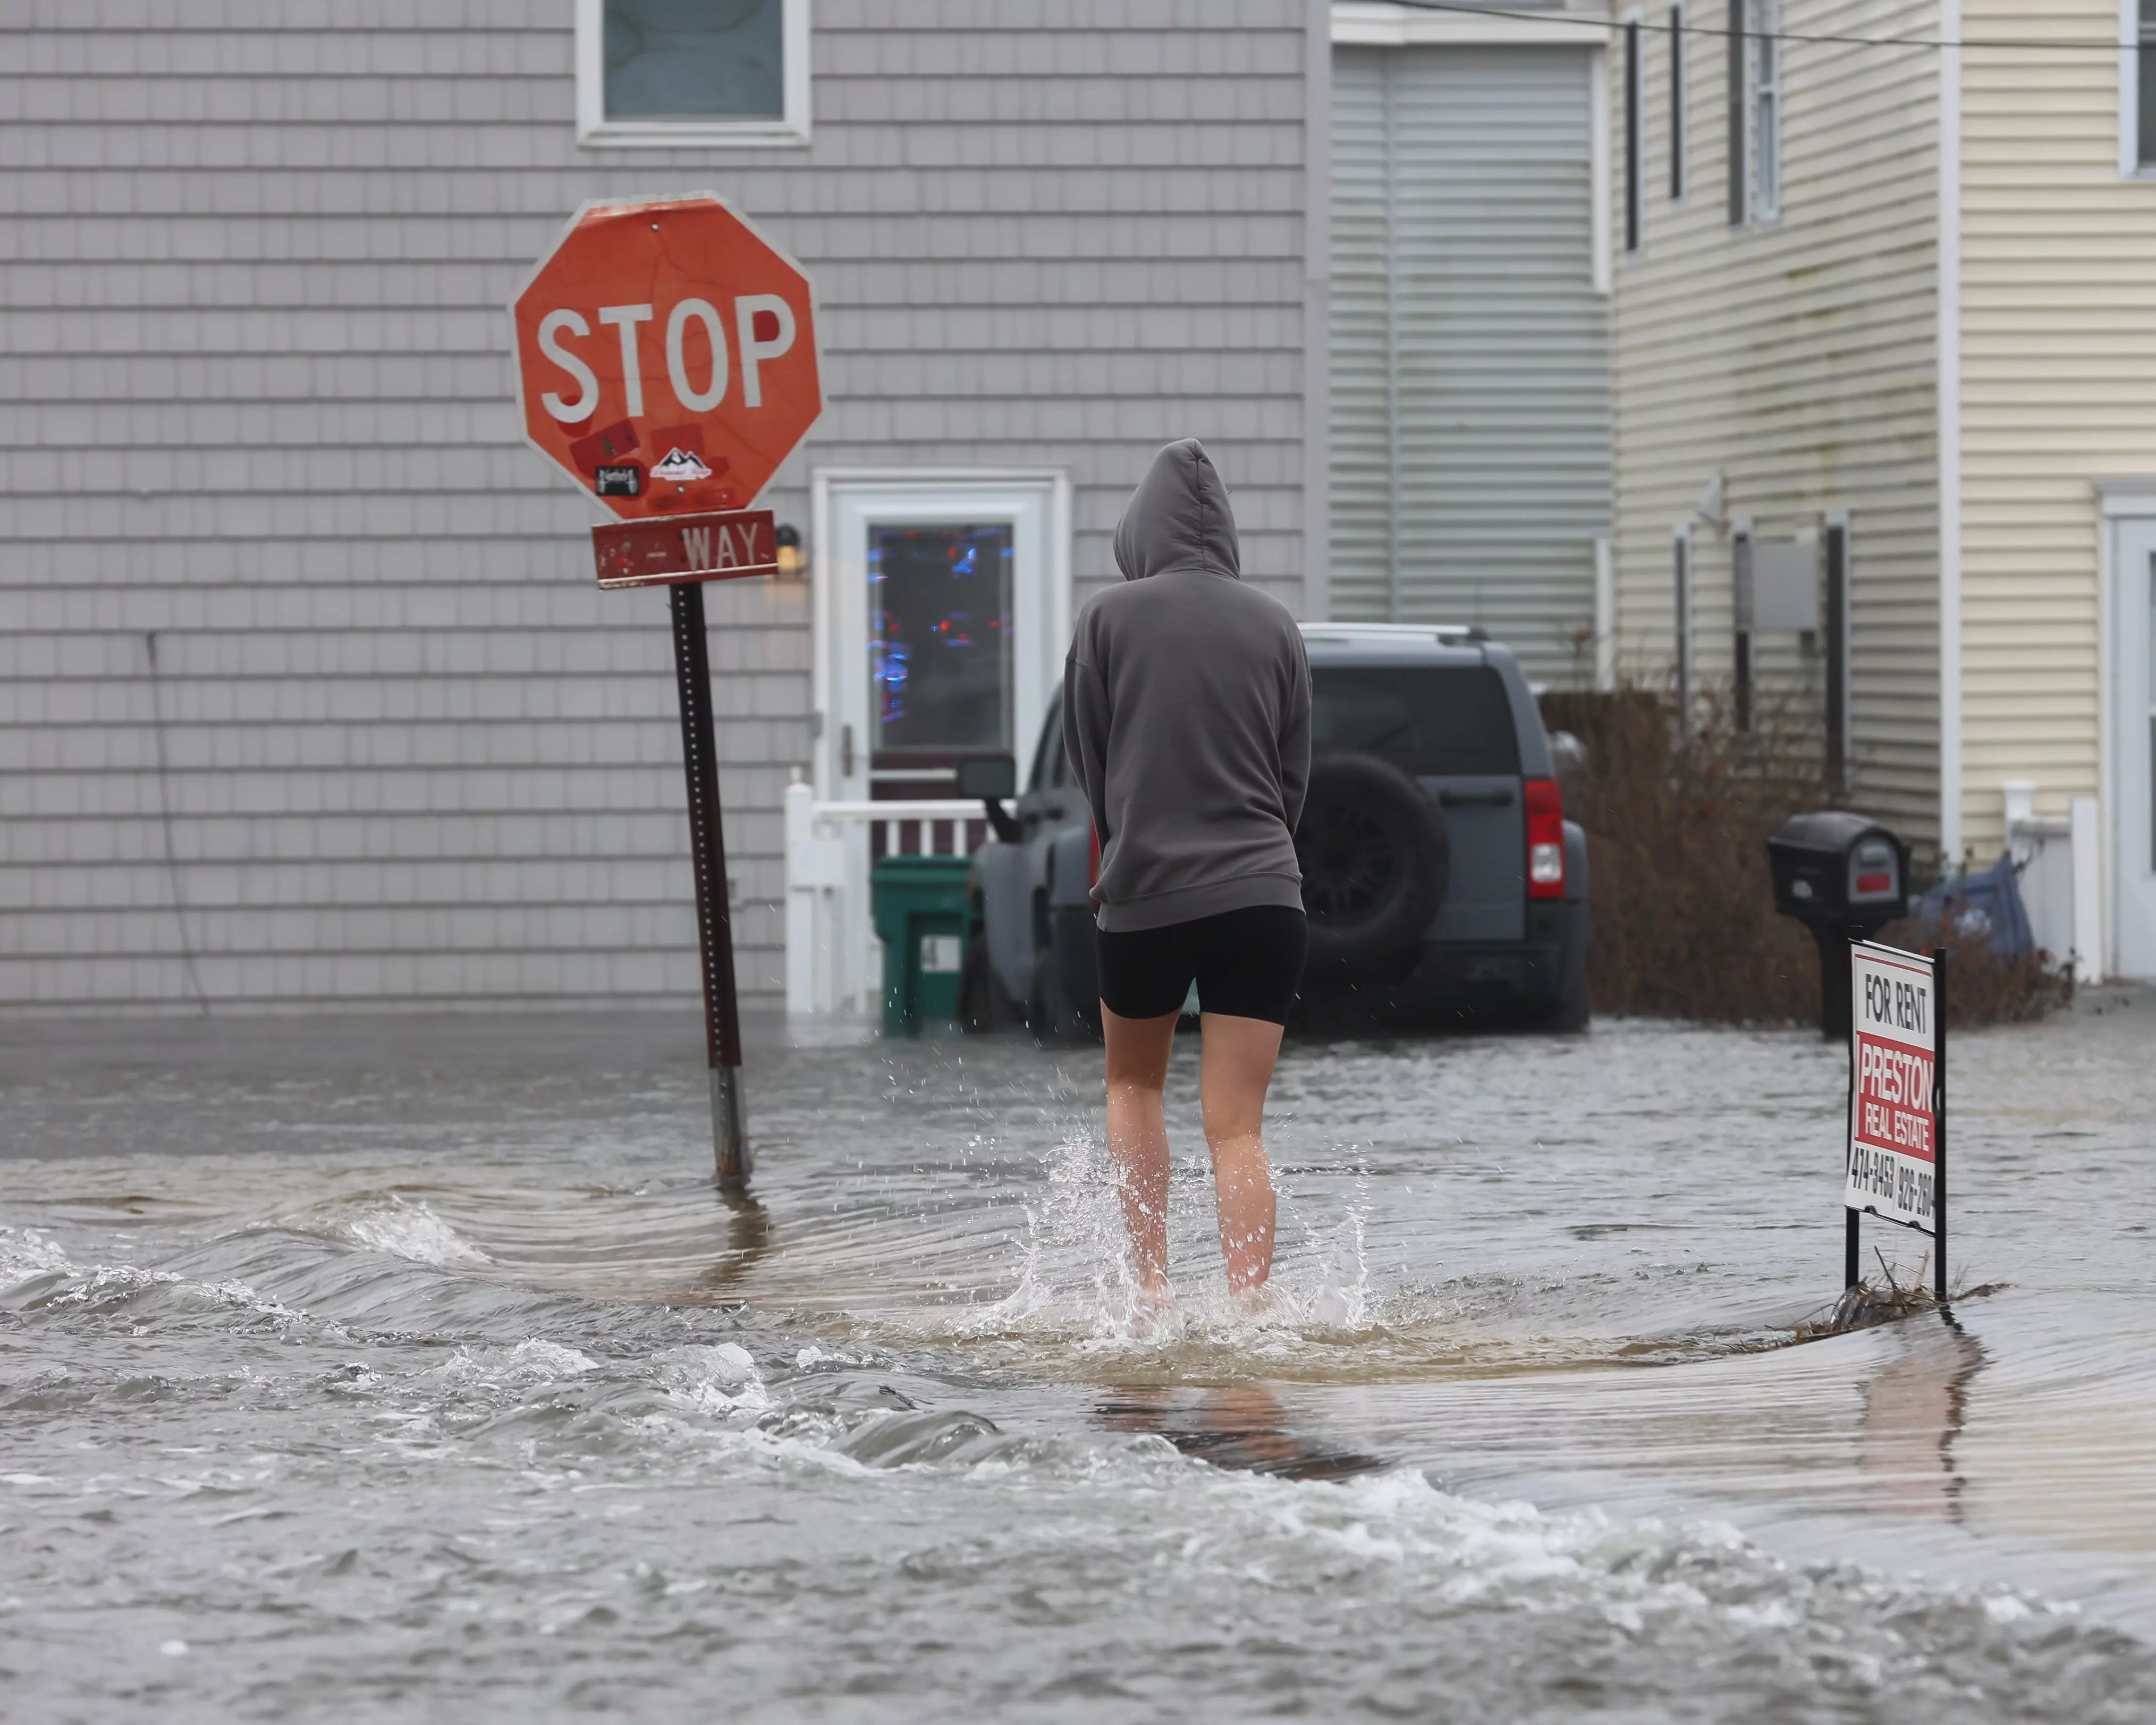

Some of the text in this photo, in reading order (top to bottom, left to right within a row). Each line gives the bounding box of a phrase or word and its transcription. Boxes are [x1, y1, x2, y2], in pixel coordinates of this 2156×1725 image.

[538, 293, 796, 423] STOP
[1865, 973, 1926, 1034] FOR RENT
[1859, 1043, 1934, 1113] PRESTON
[1865, 1102, 1930, 1152] REAL ESTATE
